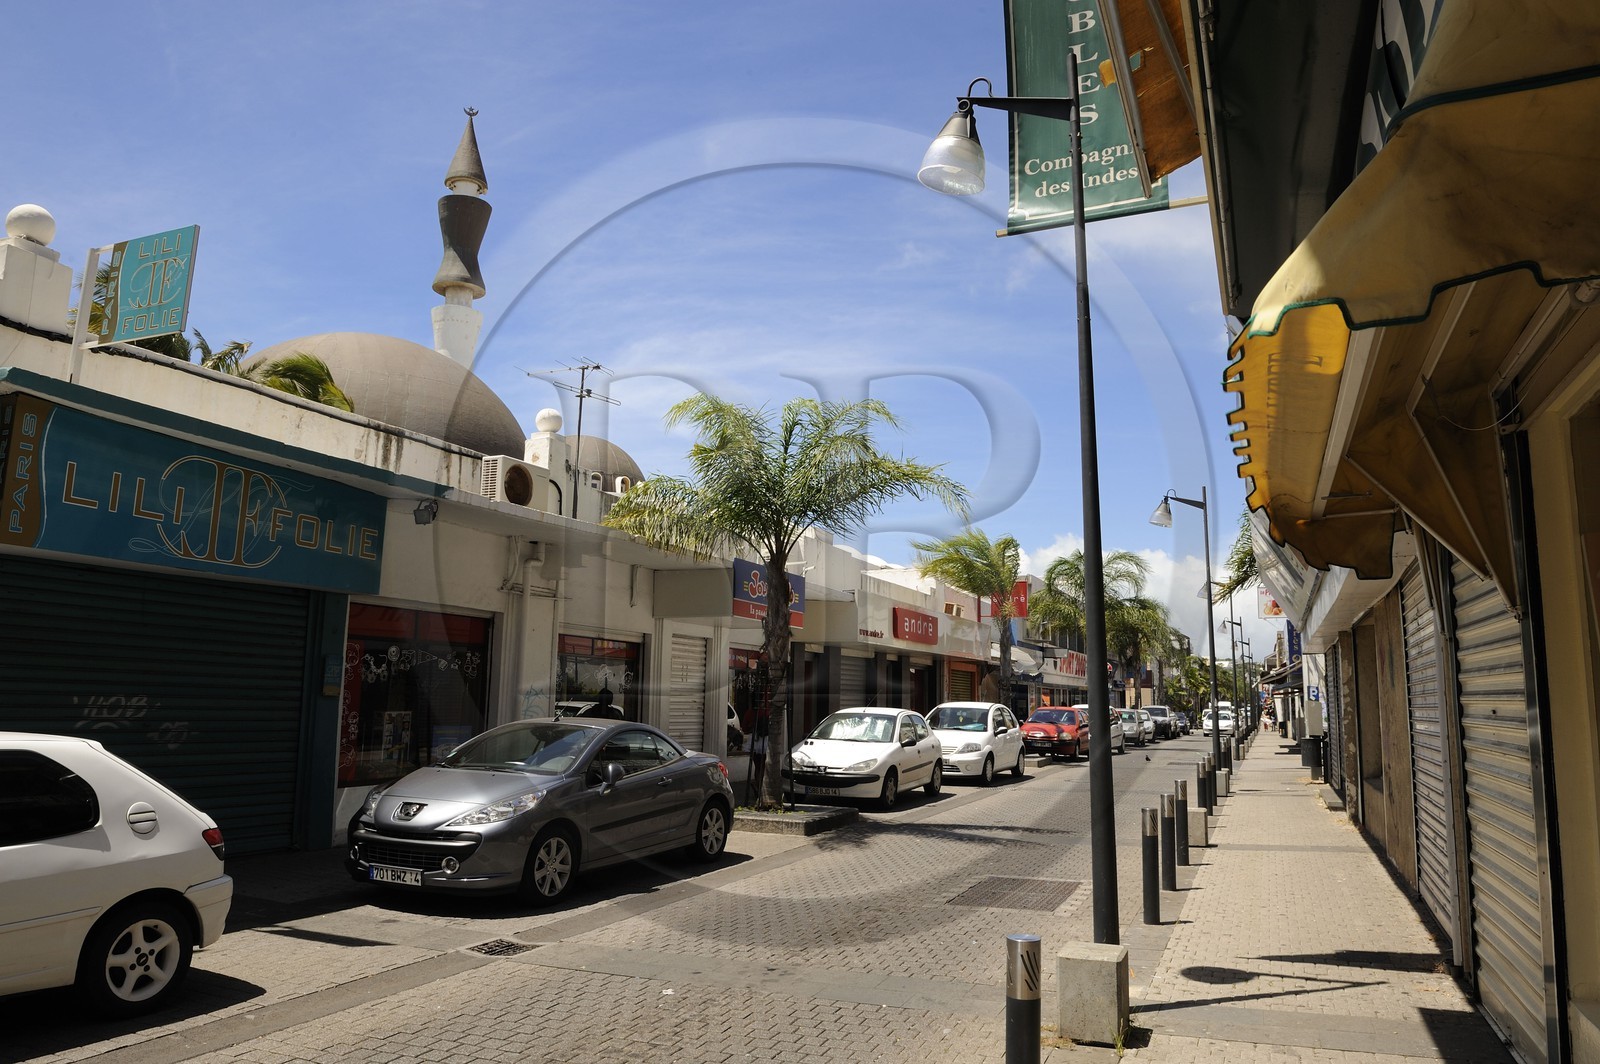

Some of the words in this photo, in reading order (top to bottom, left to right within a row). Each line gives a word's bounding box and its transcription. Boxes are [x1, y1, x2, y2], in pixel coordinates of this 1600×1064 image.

[1034, 181, 1070, 198] des
[138, 233, 181, 259] LILI
[101, 250, 121, 336] PARIS
[122, 307, 180, 335] FOLIE
[8, 412, 38, 534] PARIS
[62, 461, 185, 525] LILI
[269, 506, 379, 561] FOLIE
[374, 867, 389, 880] 701
